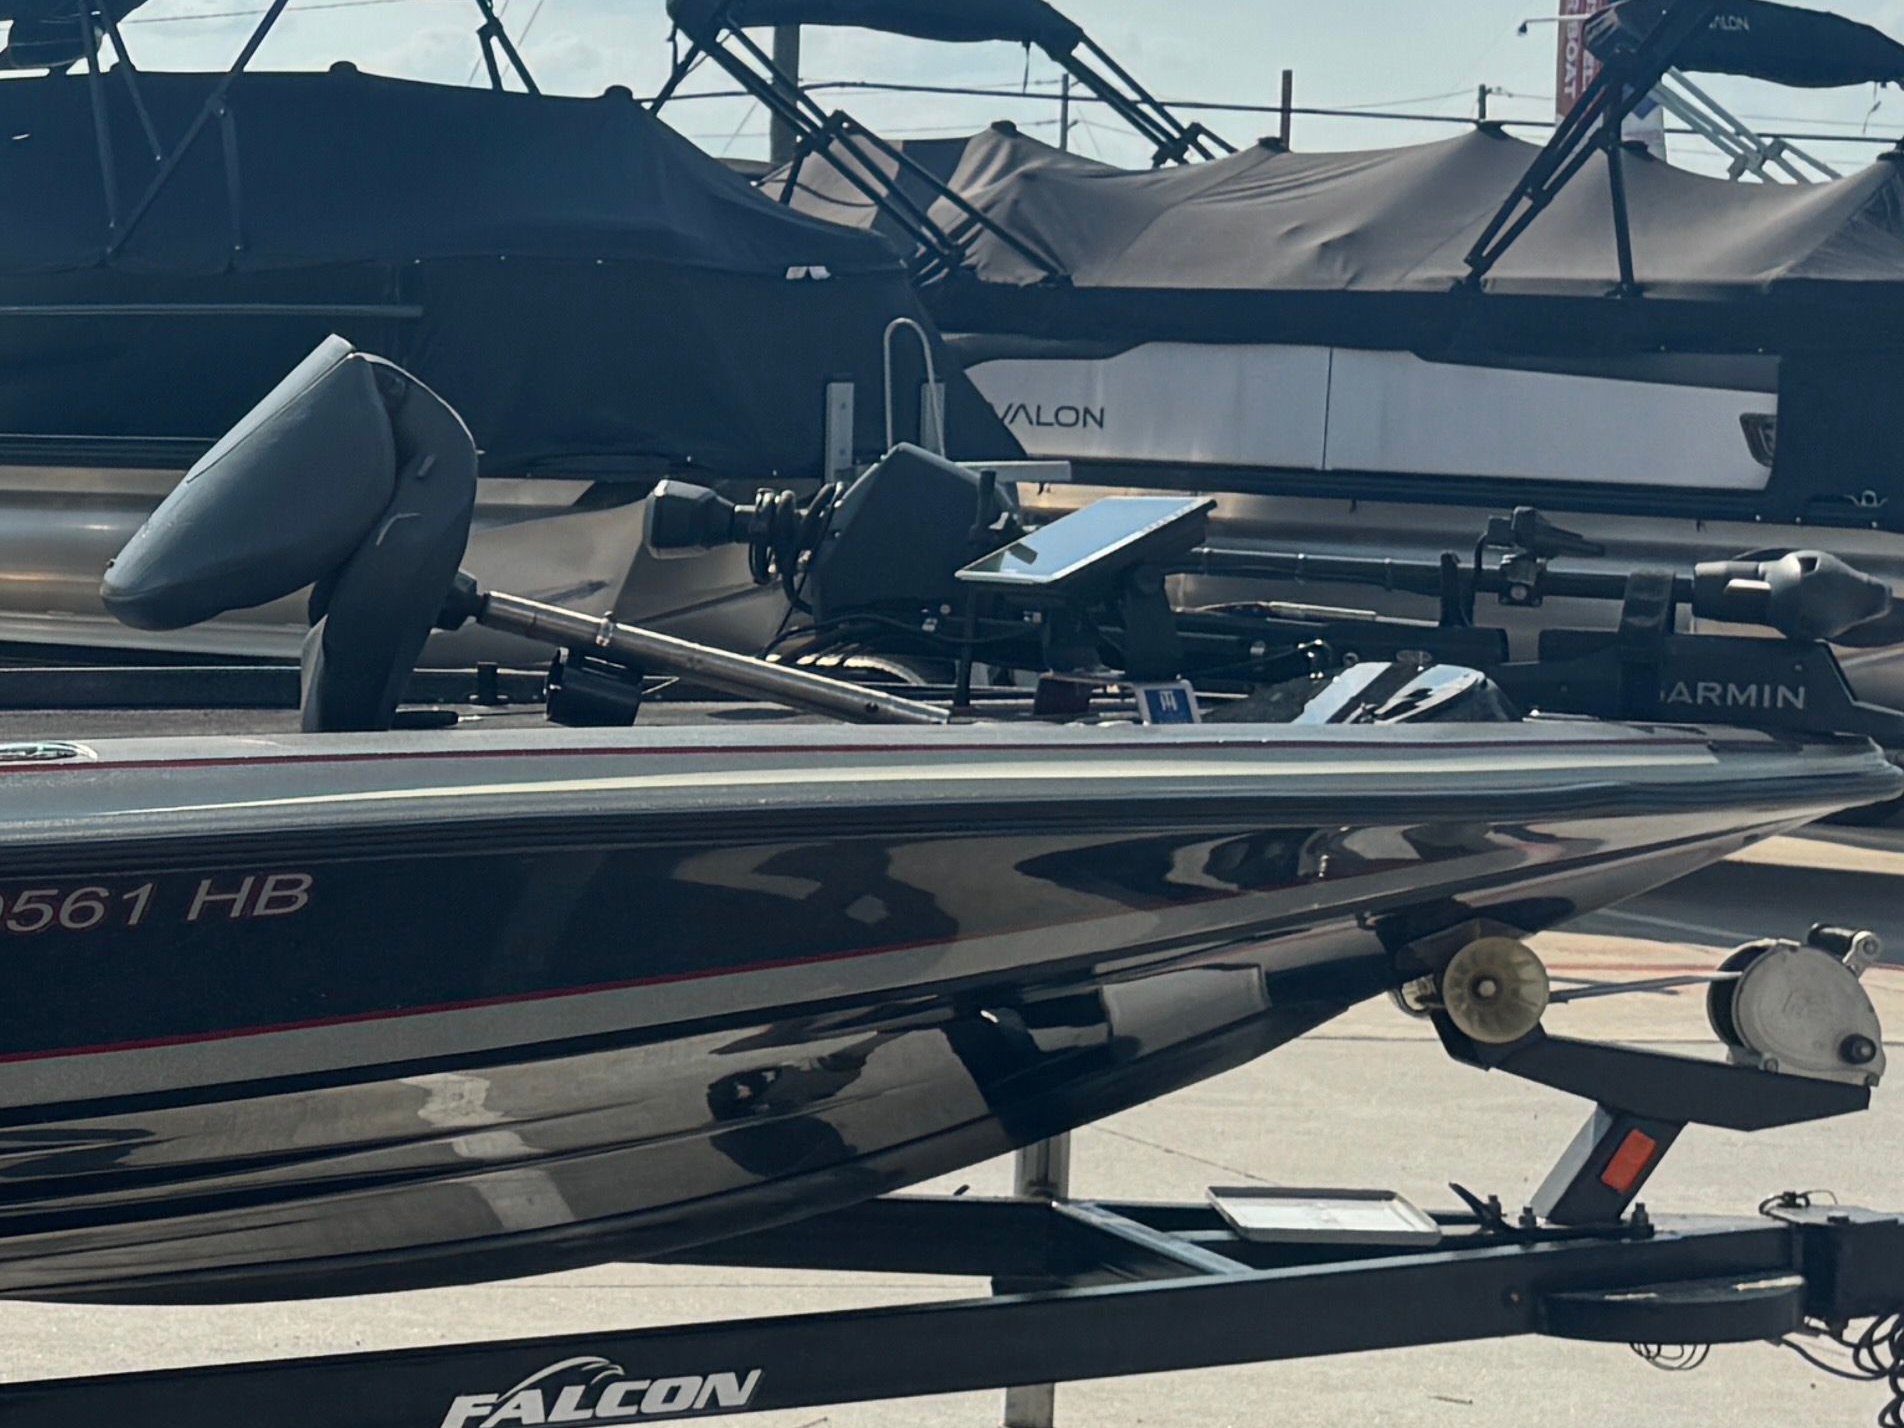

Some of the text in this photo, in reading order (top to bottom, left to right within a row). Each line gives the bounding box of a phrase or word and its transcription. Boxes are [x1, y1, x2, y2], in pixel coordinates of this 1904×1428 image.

[1564, 20, 1579, 100] BOAT
[1659, 681, 1806, 710] ARMIN
[186, 873, 314, 922] HB
